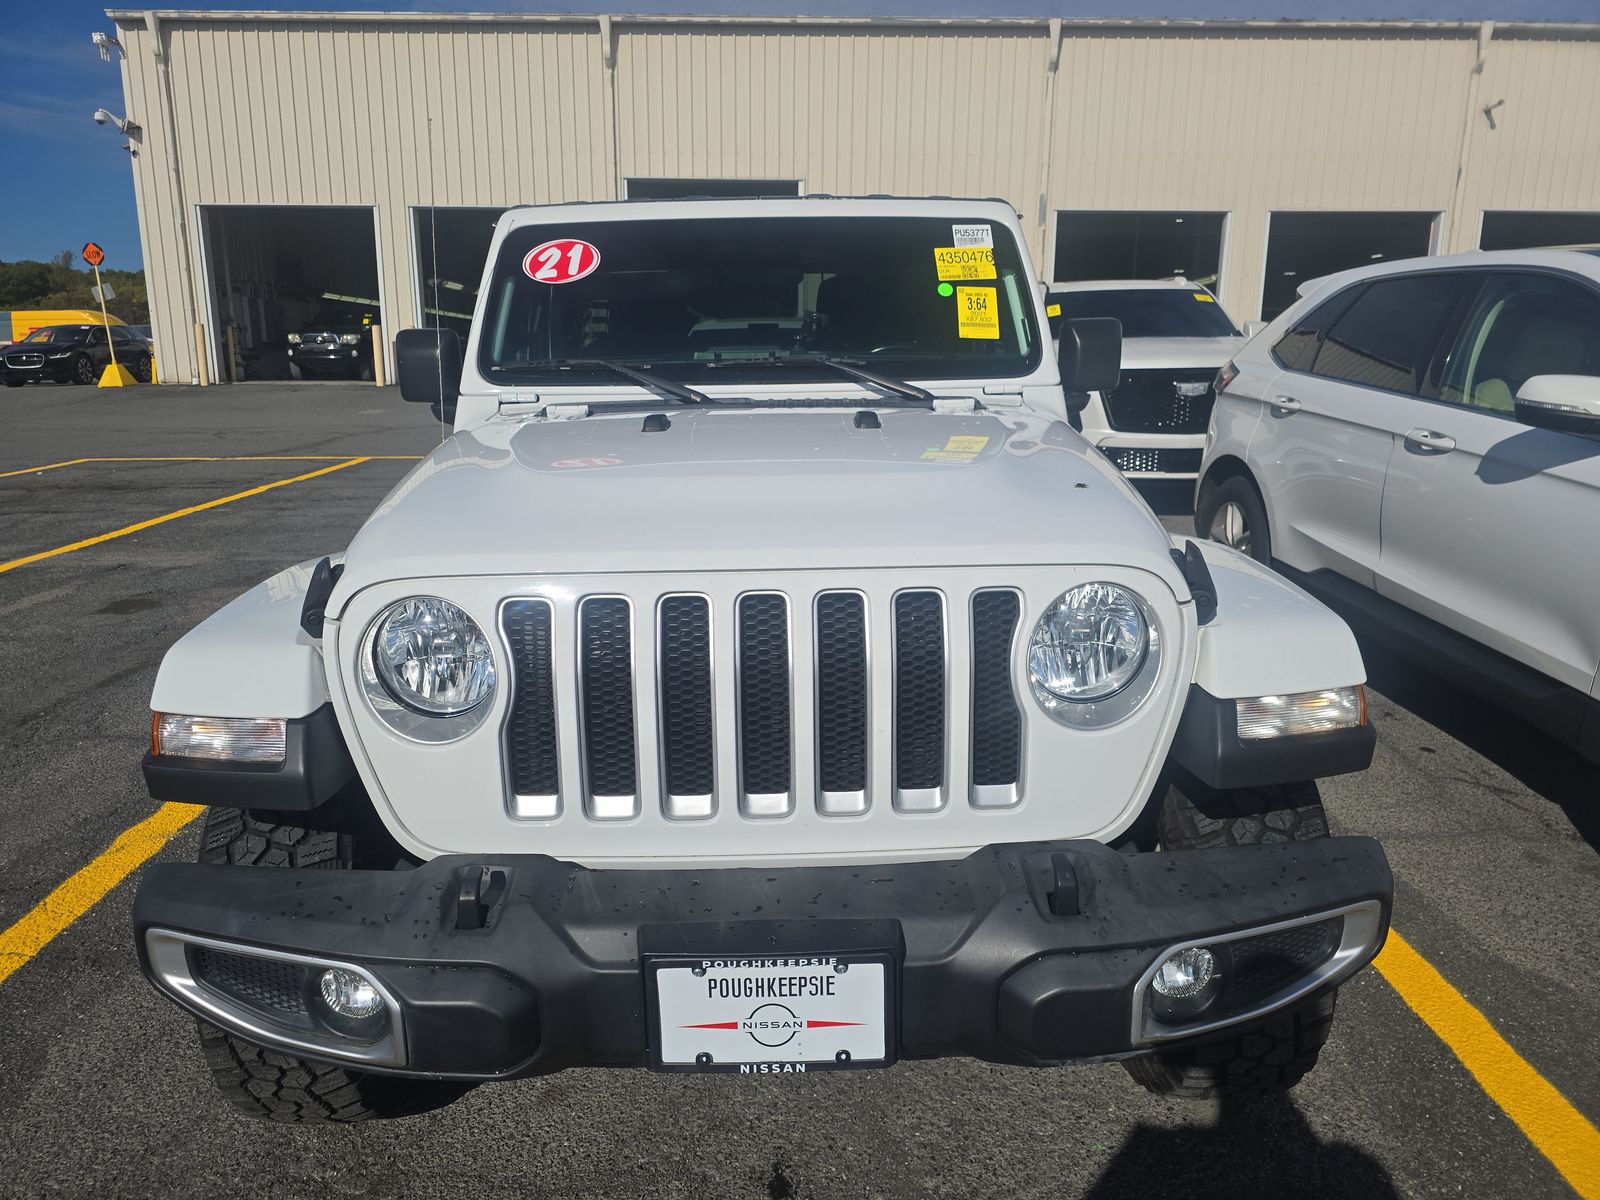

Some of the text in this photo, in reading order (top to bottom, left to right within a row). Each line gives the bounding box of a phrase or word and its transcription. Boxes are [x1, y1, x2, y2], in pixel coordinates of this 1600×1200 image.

[954, 228, 990, 238] PU5377T
[85, 249, 101, 259] SLOW
[938, 250, 994, 265] 4350476
[534, 243, 584, 280] 21
[967, 297, 988, 311] 3:64
[702, 957, 838, 969] POUGHKEEPSIE
[708, 975, 836, 999] POUGHKEEPSIE
[742, 1020, 803, 1030] NISSAN
[740, 1063, 806, 1074] NISSAN
